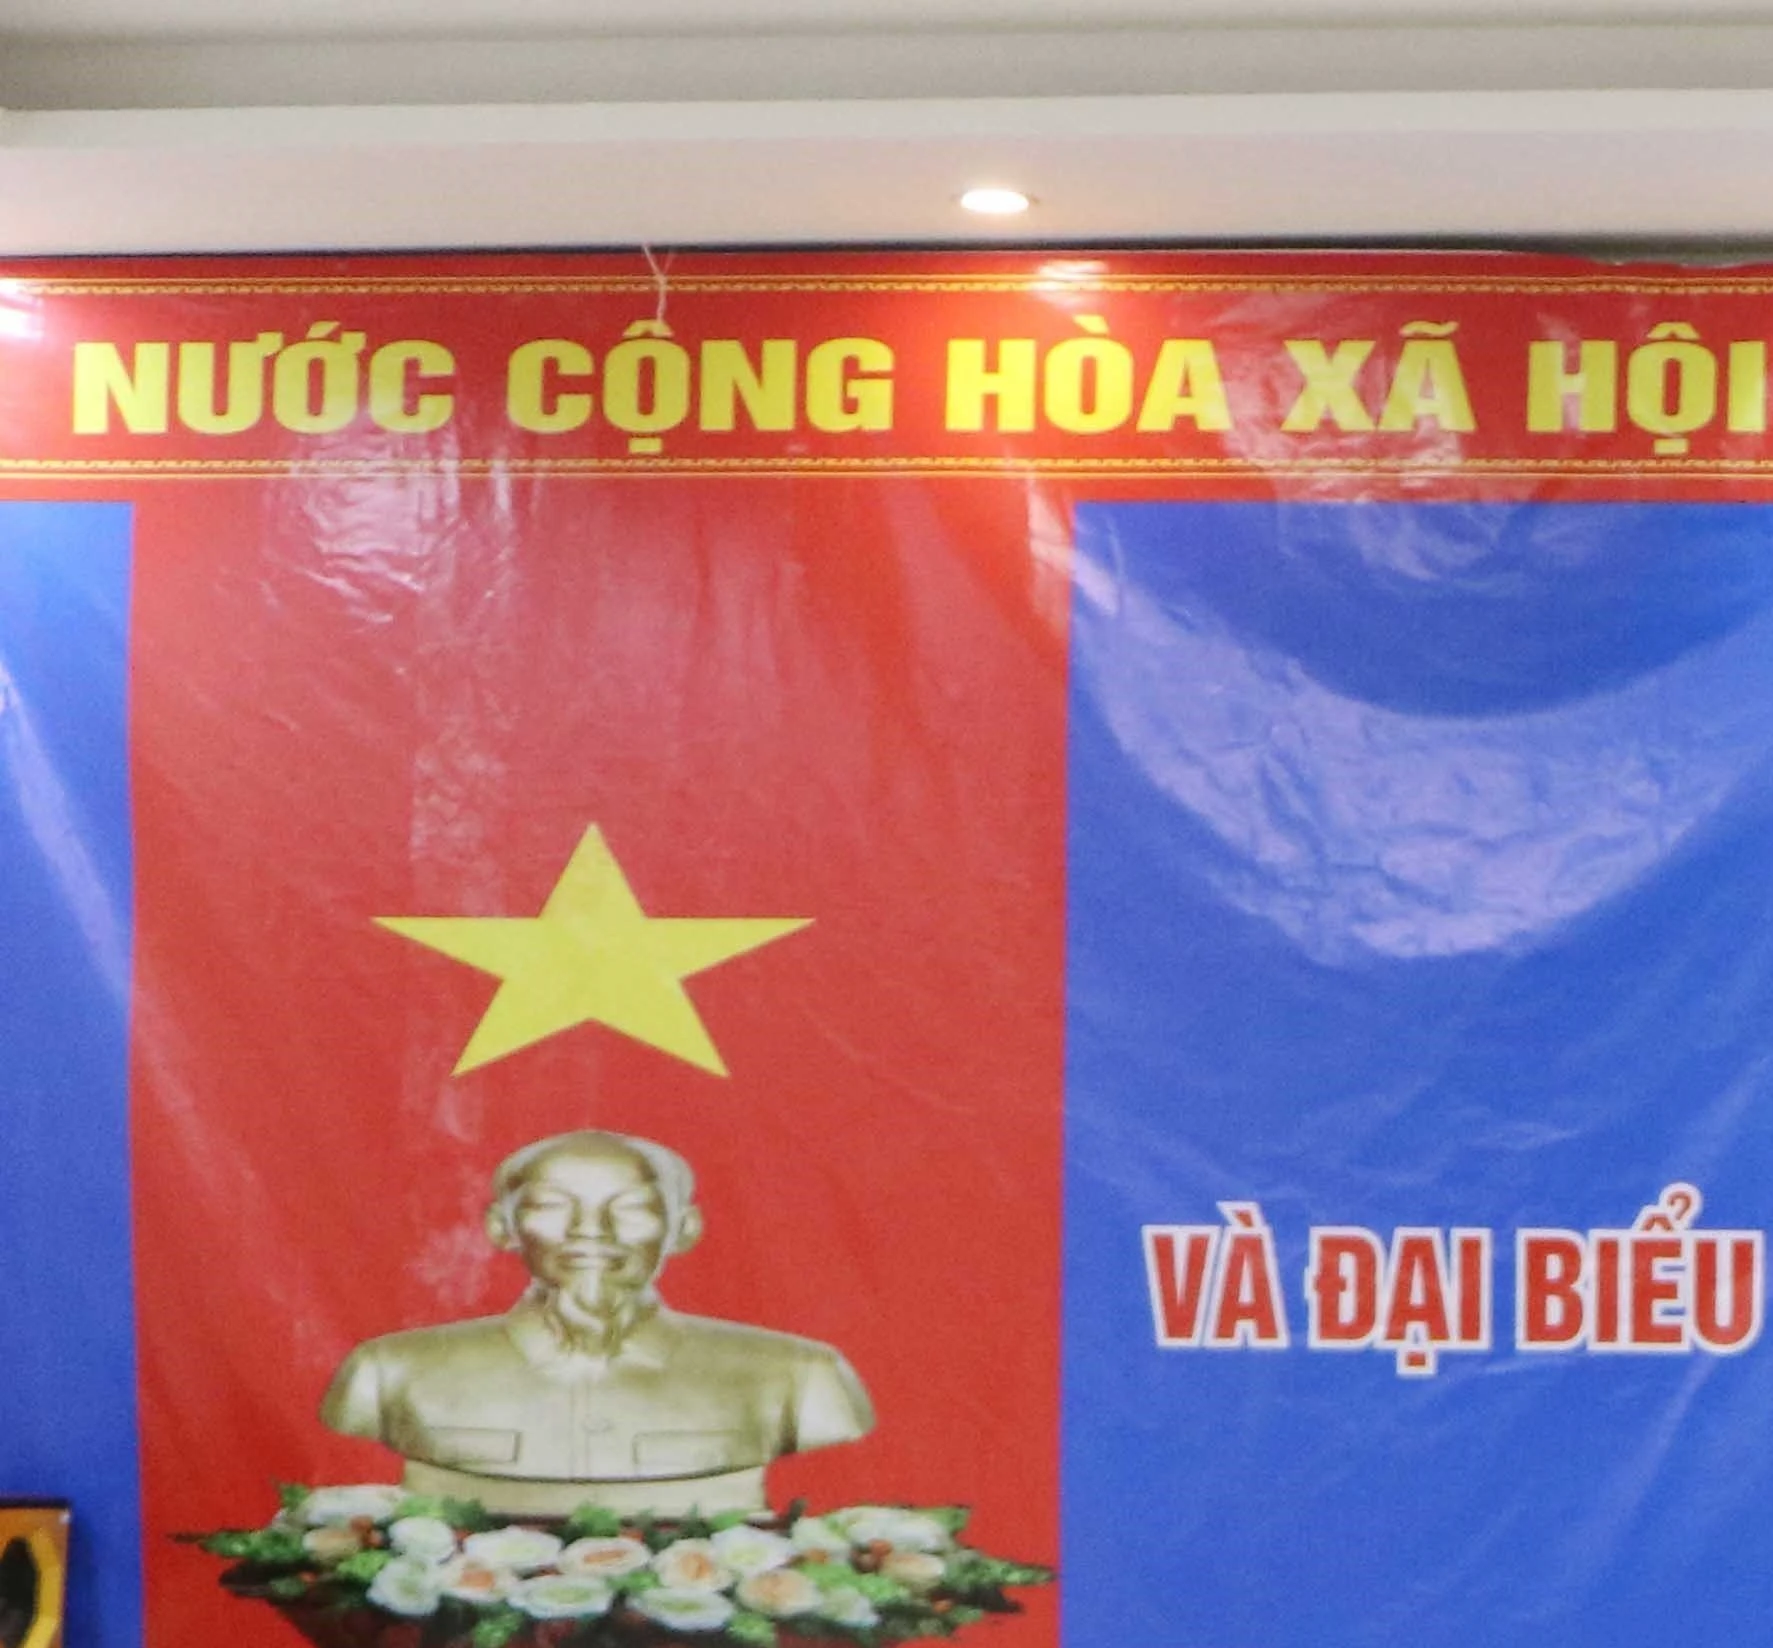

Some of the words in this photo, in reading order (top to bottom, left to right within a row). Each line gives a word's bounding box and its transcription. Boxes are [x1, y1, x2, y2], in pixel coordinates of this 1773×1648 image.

[71, 323, 454, 433] NƯỚC
[508, 322, 894, 452] CỘNG
[945, 313, 1230, 434] HÒA
[1281, 322, 1476, 431] XÃ
[1528, 322, 1766, 455] HỘI
[1143, 1202, 1289, 1349] VÀ
[1305, 1226, 1492, 1375] ĐẠI
[1516, 1183, 1764, 1355] BIỂU
